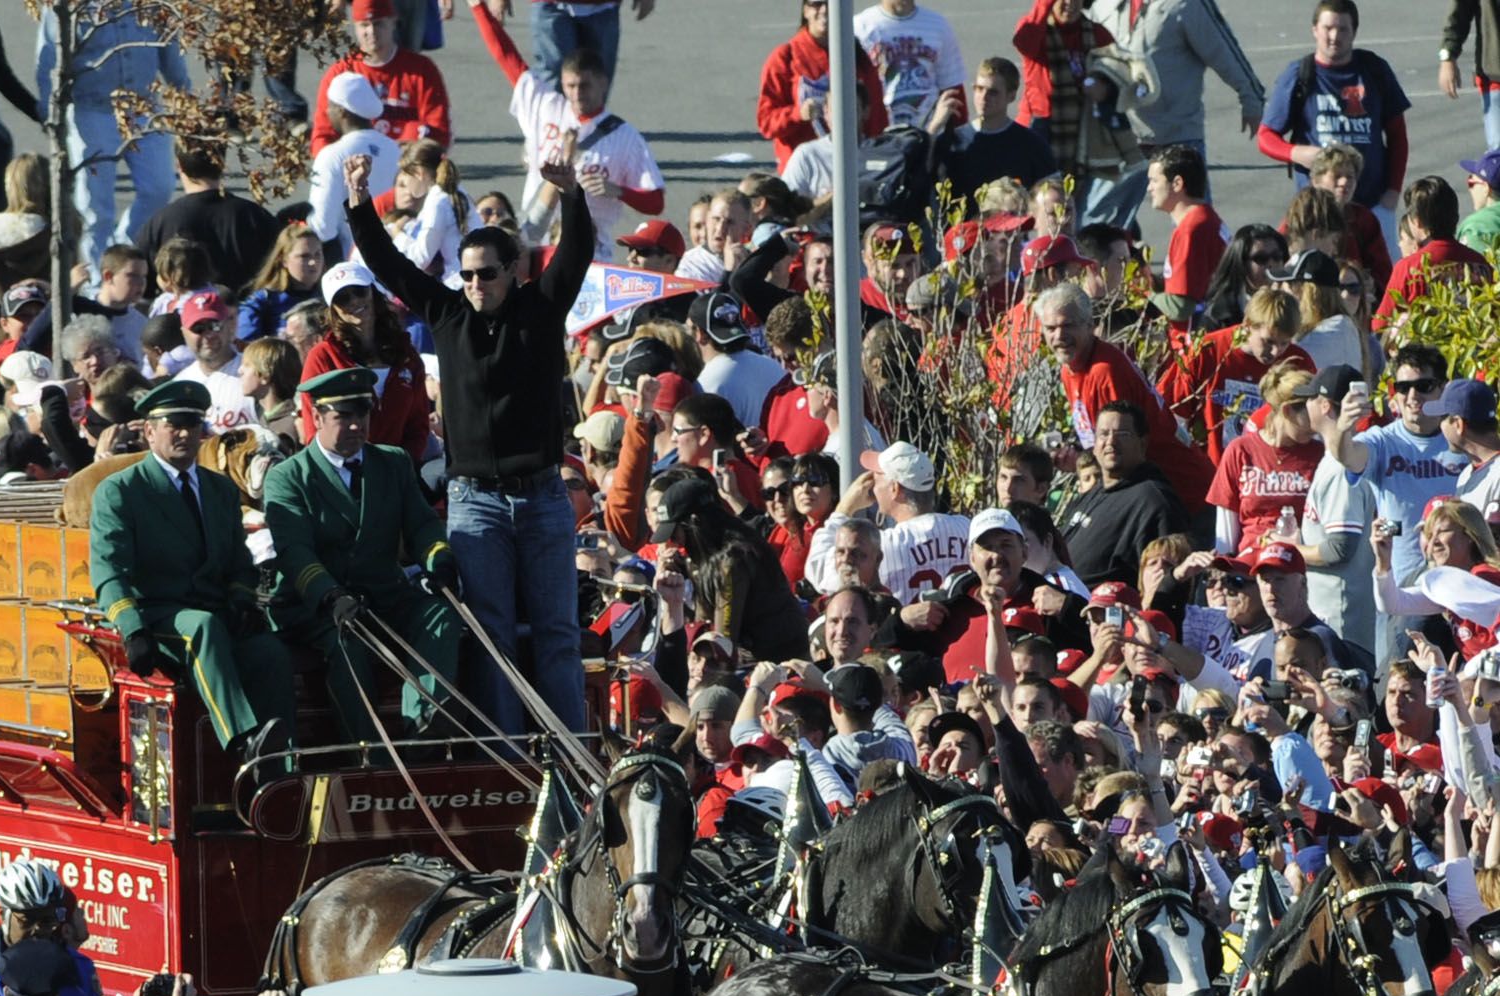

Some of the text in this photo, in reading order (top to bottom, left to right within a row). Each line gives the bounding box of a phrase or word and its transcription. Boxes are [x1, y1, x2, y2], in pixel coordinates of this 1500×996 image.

[1385, 455, 1468, 480] Phillie
[910, 536, 969, 566] UTLEY
[348, 788, 543, 813] Budweiser
